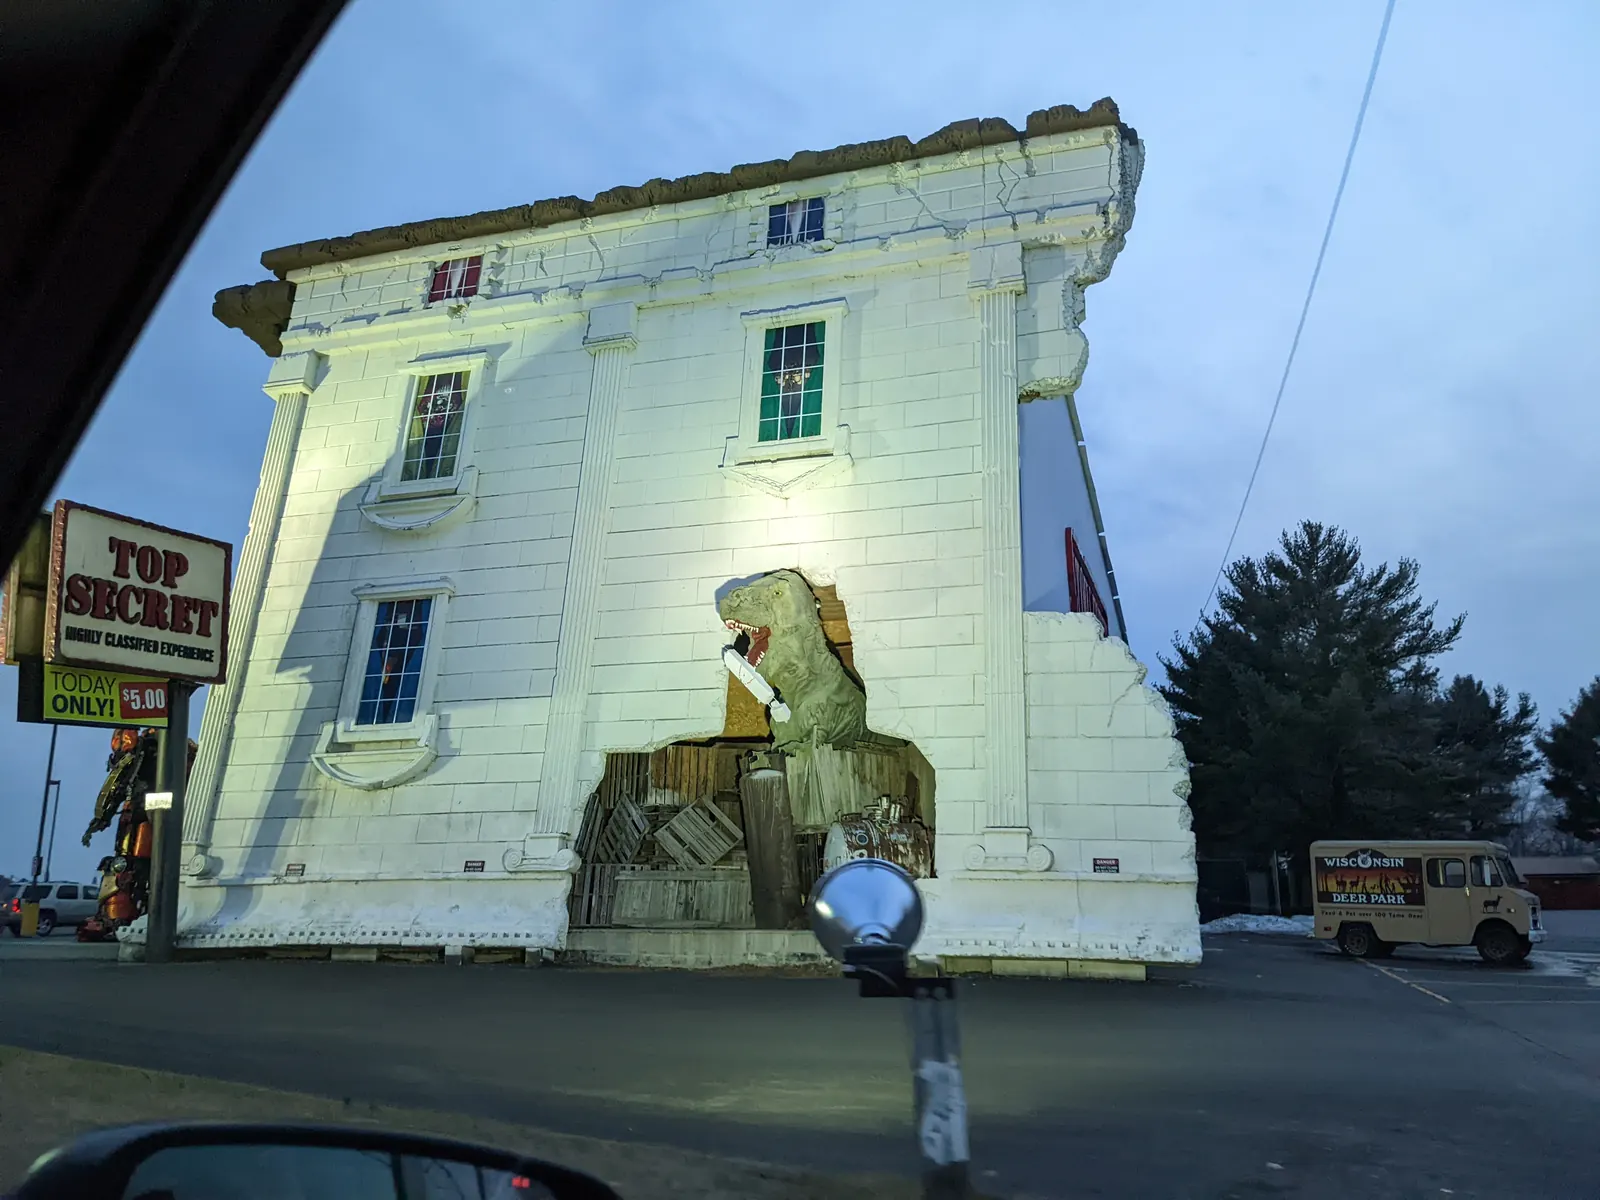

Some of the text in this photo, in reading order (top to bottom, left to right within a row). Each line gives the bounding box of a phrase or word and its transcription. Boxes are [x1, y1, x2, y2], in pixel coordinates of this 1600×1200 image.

[108, 536, 189, 589] TOP
[64, 573, 219, 638] SECRET
[65, 625, 214, 662] HIGHLY CLASSIFIED EXPERIENCE
[51, 671, 117, 696] TODAY
[52, 694, 114, 717] ONLY!
[123, 688, 165, 710] $5.00
[1324, 856, 1404, 868] WISCONSIN
[1332, 893, 1406, 904] DEER PARK
